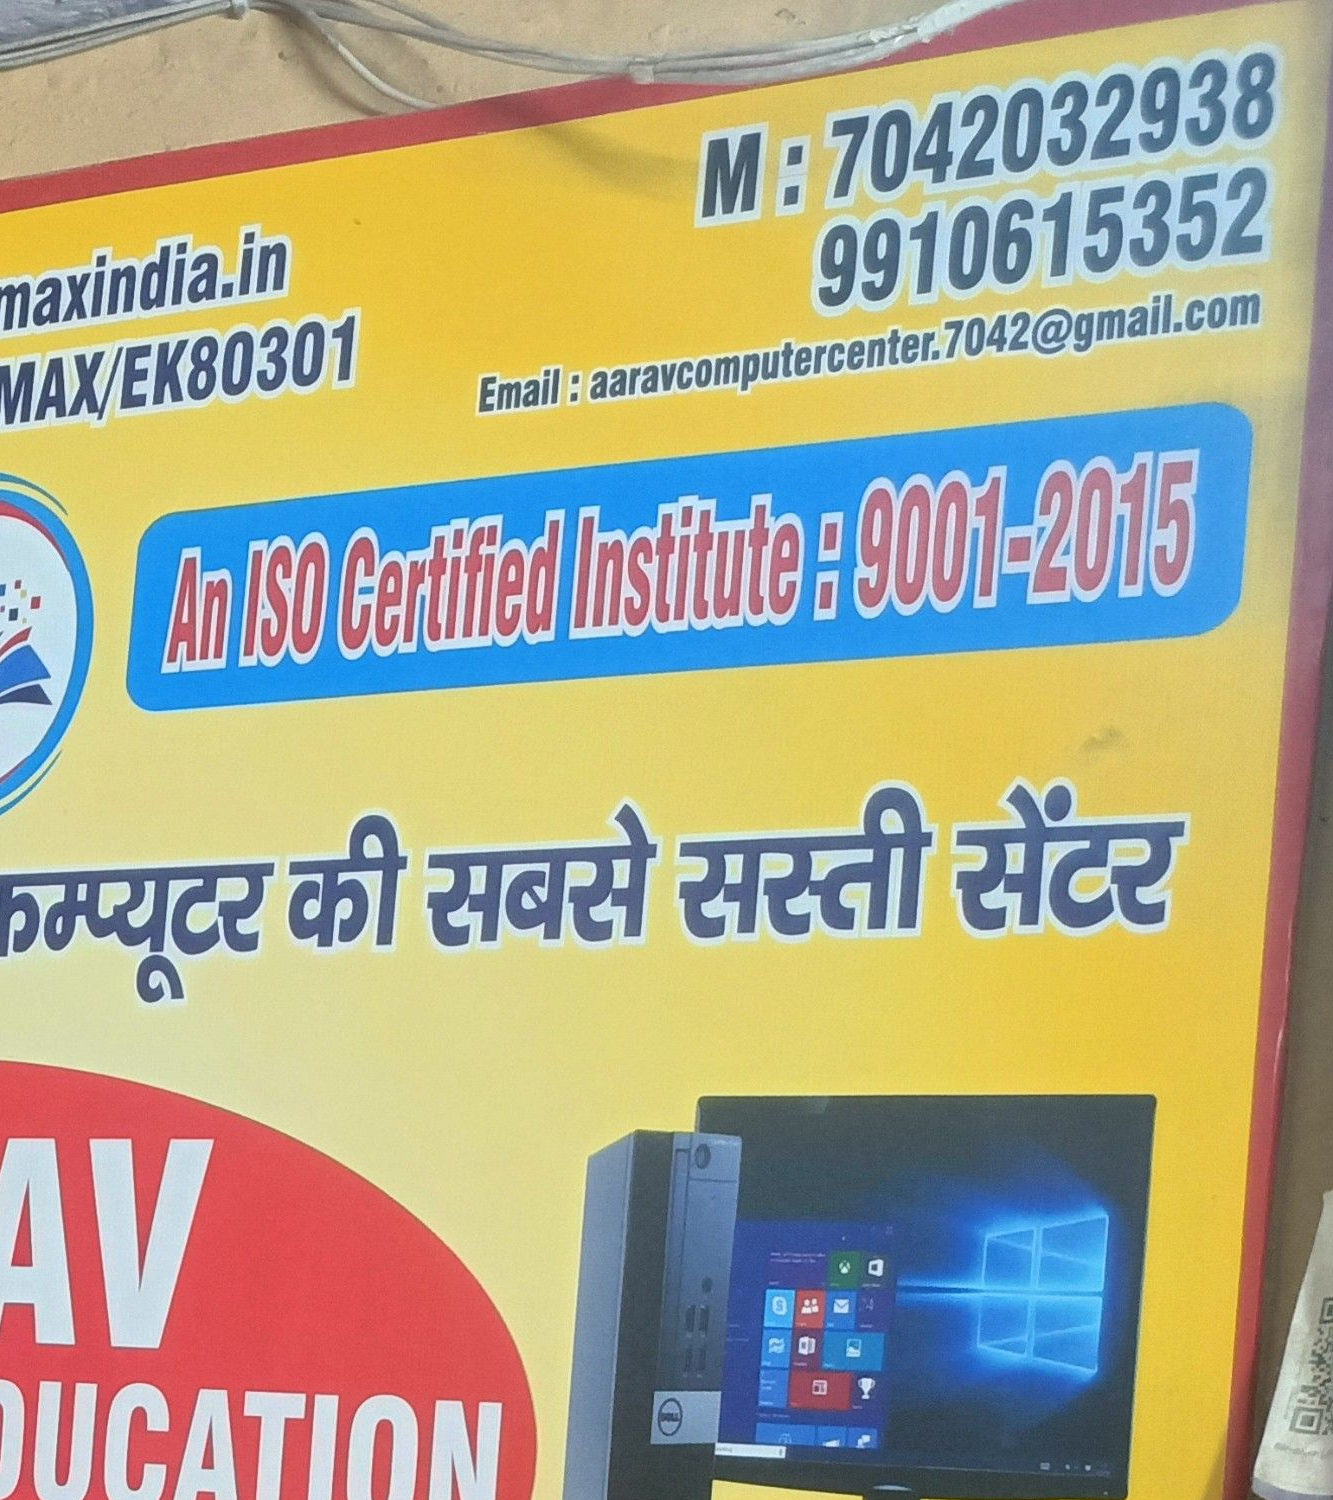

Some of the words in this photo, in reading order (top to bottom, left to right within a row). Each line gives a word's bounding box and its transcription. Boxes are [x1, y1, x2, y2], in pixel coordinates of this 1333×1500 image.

[700, 132, 762, 219] M
[783, 143, 804, 208] :
[830, 51, 1277, 200] 7042032938
[818, 167, 1269, 308] 9910615352
[478, 369, 560, 414] Email
[589, 293, 1262, 401] aaravcomputercenter.7042@gmail.com
[166, 555, 227, 671] An
[249, 542, 326, 666] ISO
[340, 517, 564, 655] Certified
[574, 497, 802, 633] Institute
[818, 520, 839, 611] :
[858, 460, 1199, 612] 9001-2015
[287, 814, 409, 949] की
[427, 803, 656, 949] सबसे
[678, 780, 932, 938] सस्ती
[956, 776, 1186, 931] सेंटर
